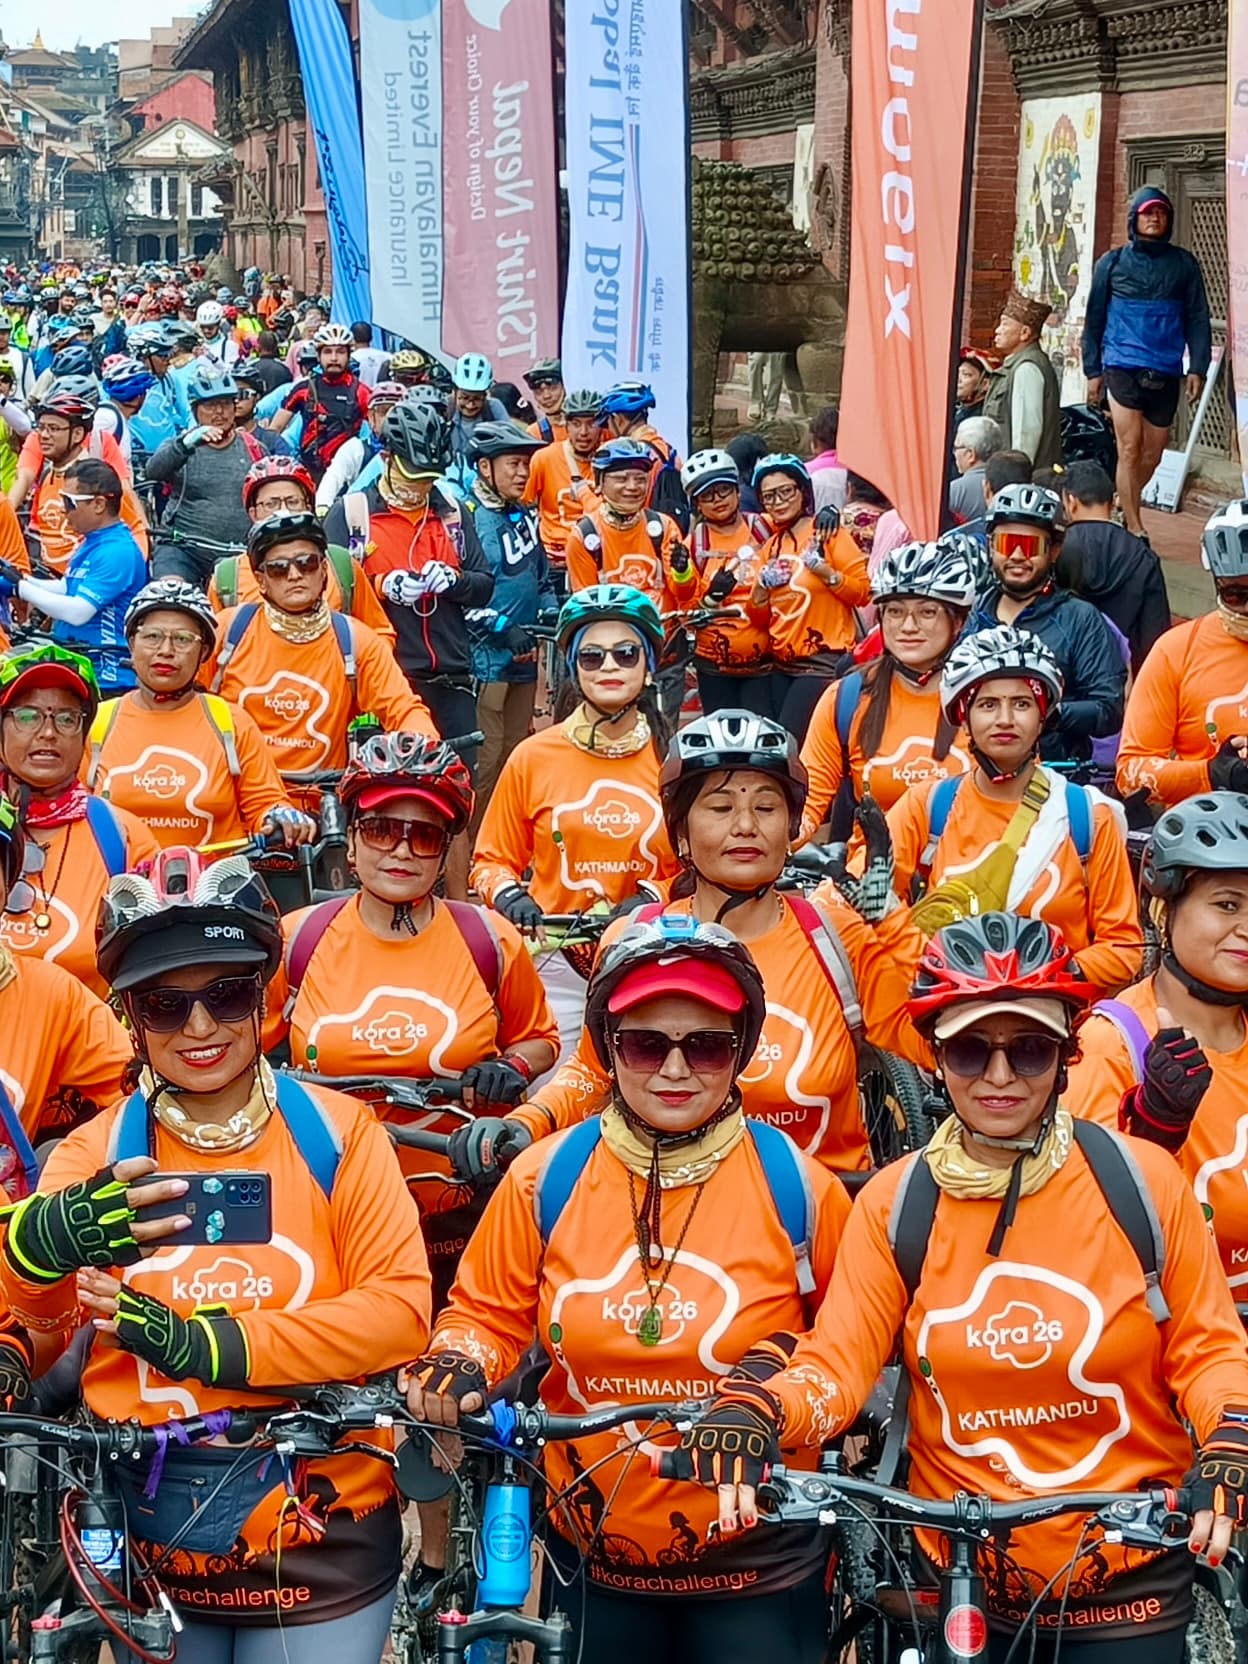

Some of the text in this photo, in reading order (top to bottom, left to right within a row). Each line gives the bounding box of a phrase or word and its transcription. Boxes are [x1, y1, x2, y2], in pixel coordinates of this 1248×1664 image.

[264, 695, 294, 711] kora
[133, 774, 167, 787] kora
[892, 766, 928, 780] kora
[583, 811, 620, 825] kora
[351, 1022, 427, 1041] kora 26
[758, 1042, 782, 1060] 26
[173, 1276, 273, 1300] kora 26
[602, 1299, 698, 1320] kora 26
[966, 1319, 1064, 1348] kora 26
[957, 1399, 1099, 1432] KATHMANDU
[590, 1566, 758, 1592] #korachallenge
